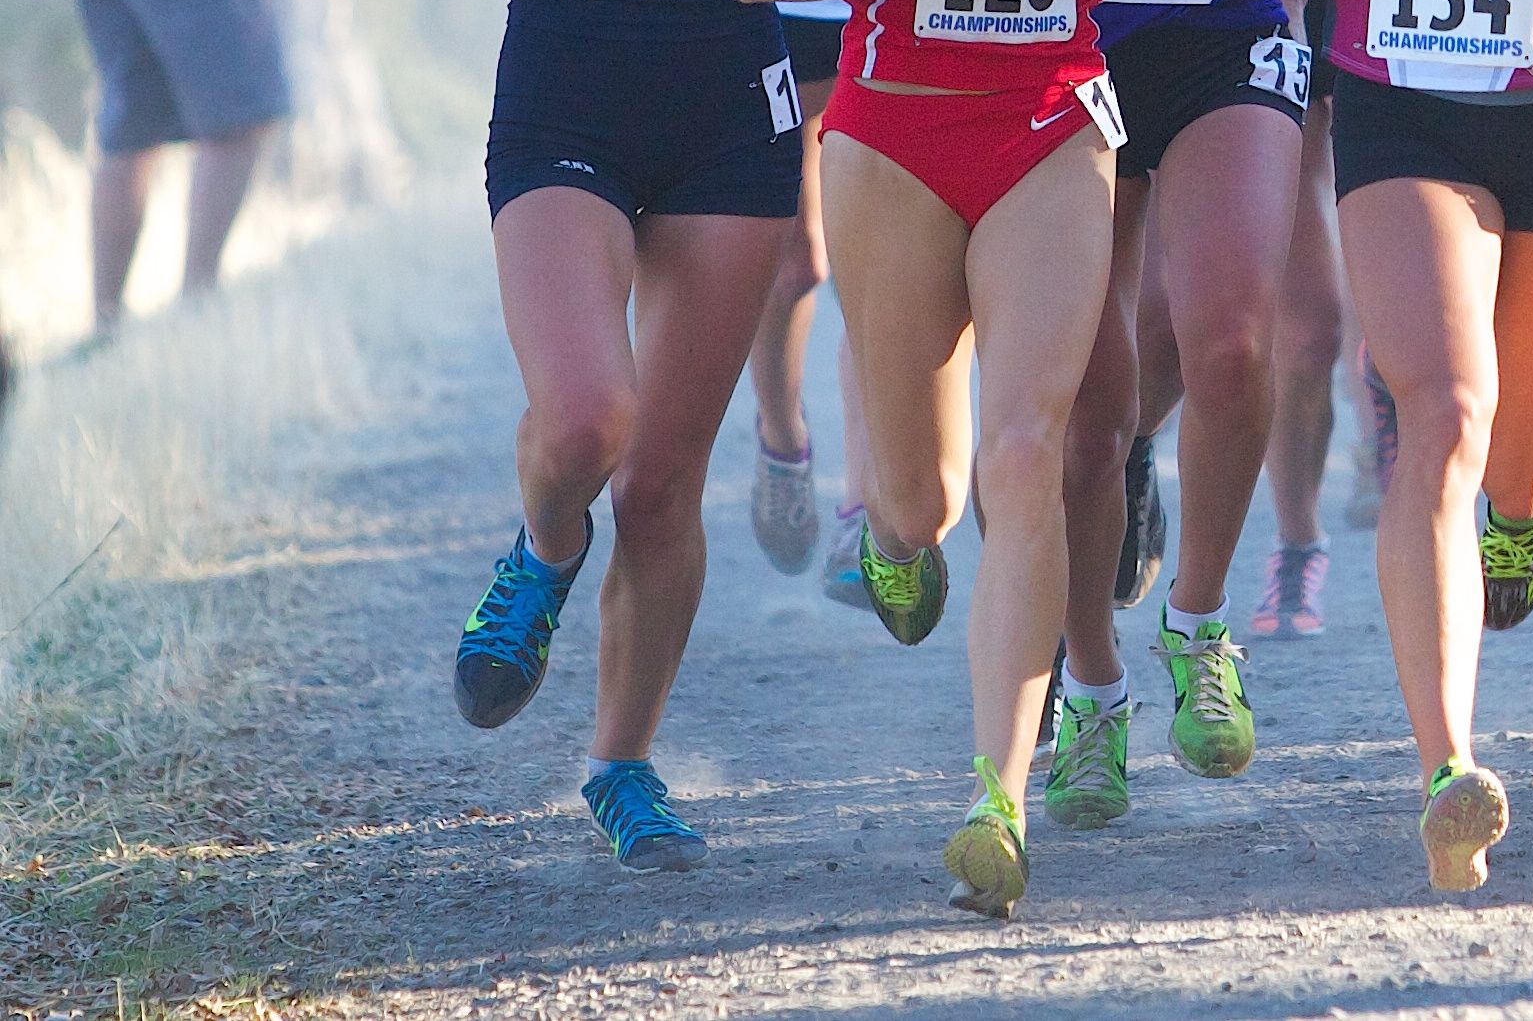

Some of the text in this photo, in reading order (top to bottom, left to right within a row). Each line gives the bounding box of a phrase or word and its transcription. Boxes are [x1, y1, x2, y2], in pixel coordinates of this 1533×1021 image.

[928, 13, 1067, 34] CHAMPIONSHIPS
[1378, 30, 1523, 58] CHAMPIONSHIPS
[1262, 42, 1310, 103] 15
[1091, 74, 1121, 136] 1
